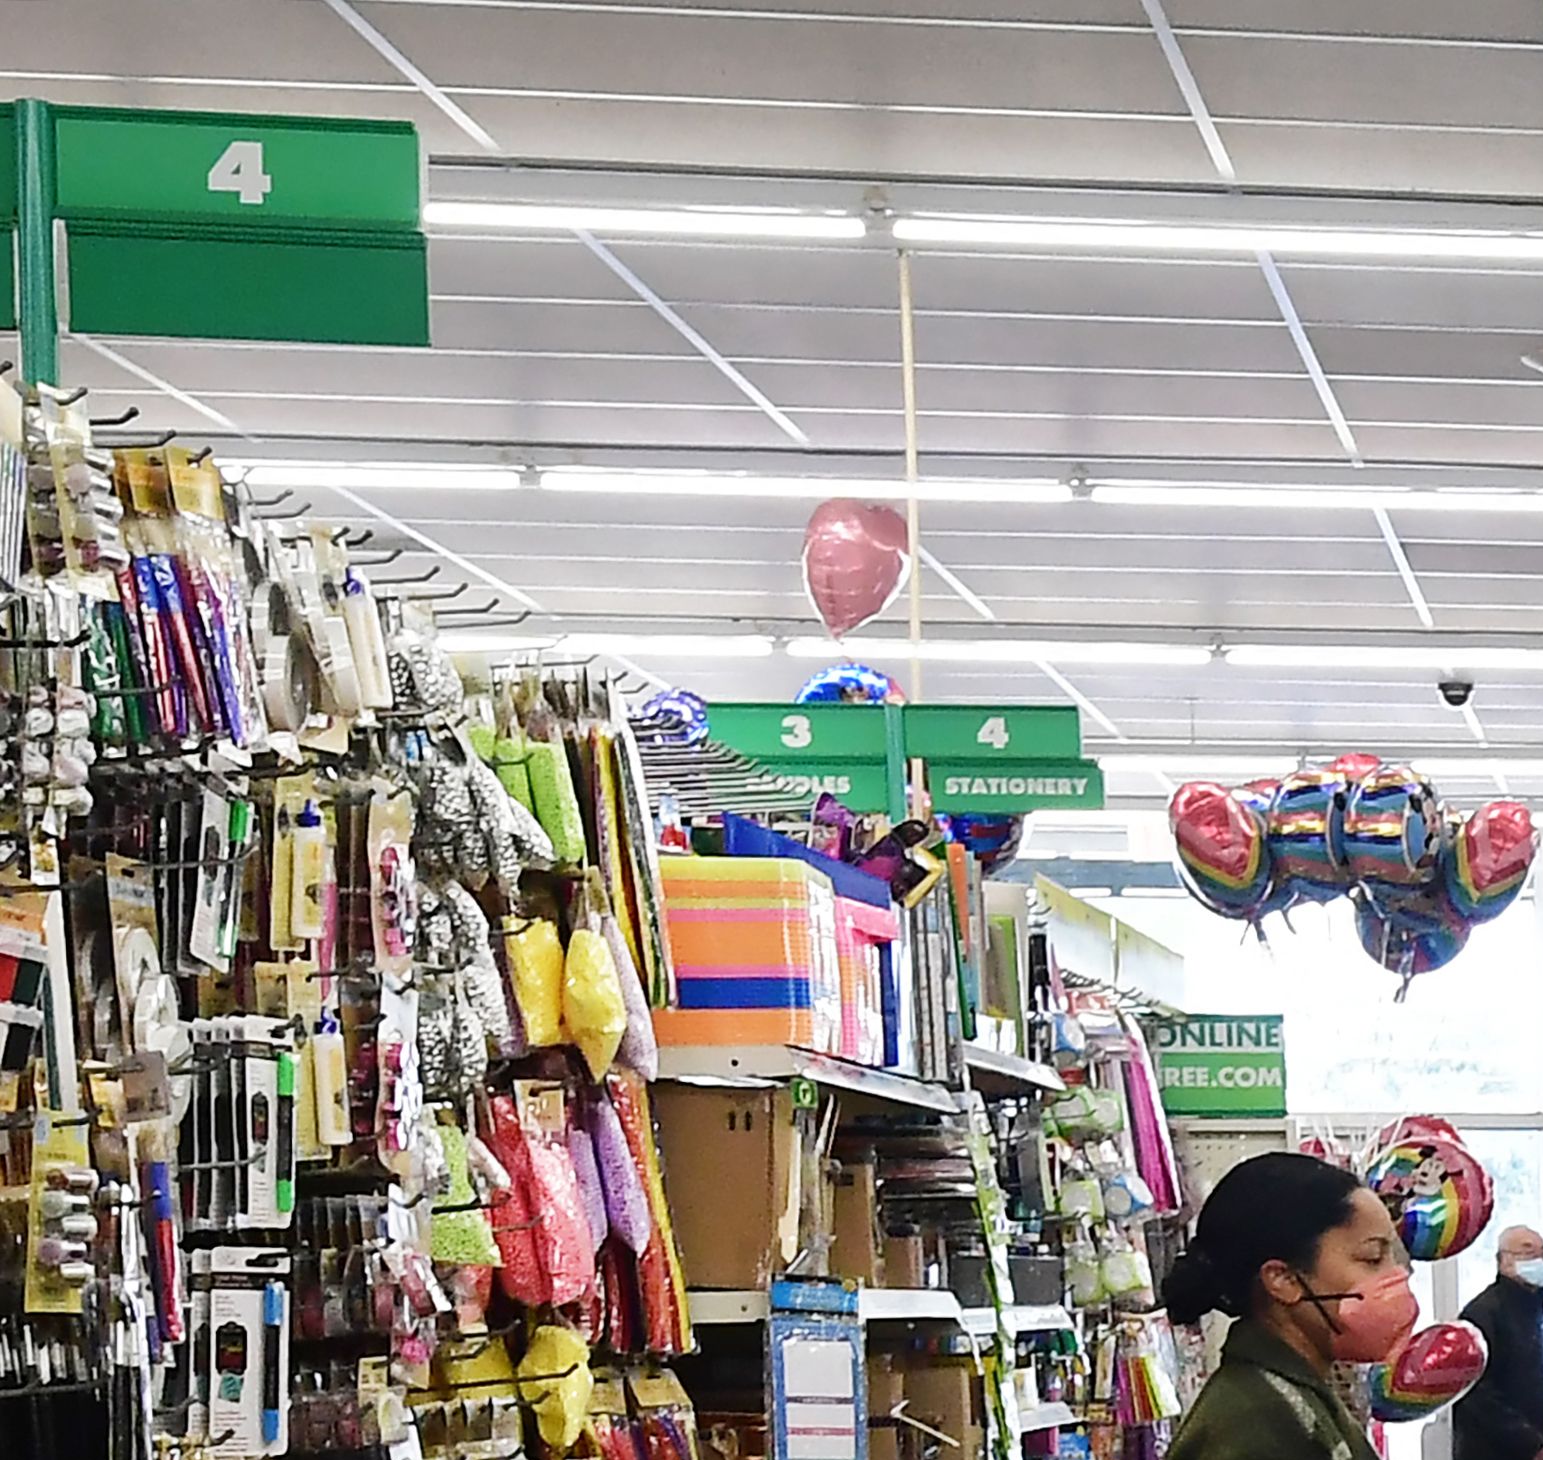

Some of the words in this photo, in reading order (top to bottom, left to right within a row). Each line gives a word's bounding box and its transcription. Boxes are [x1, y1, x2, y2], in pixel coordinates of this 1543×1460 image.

[207, 142, 271, 205] 4
[780, 715, 813, 748] 3
[976, 716, 1010, 749] 4
[945, 776, 1088, 796] STATIONERY
[1158, 1022, 1280, 1047] ONLINE
[1156, 1066, 1281, 1088] REE.COM
